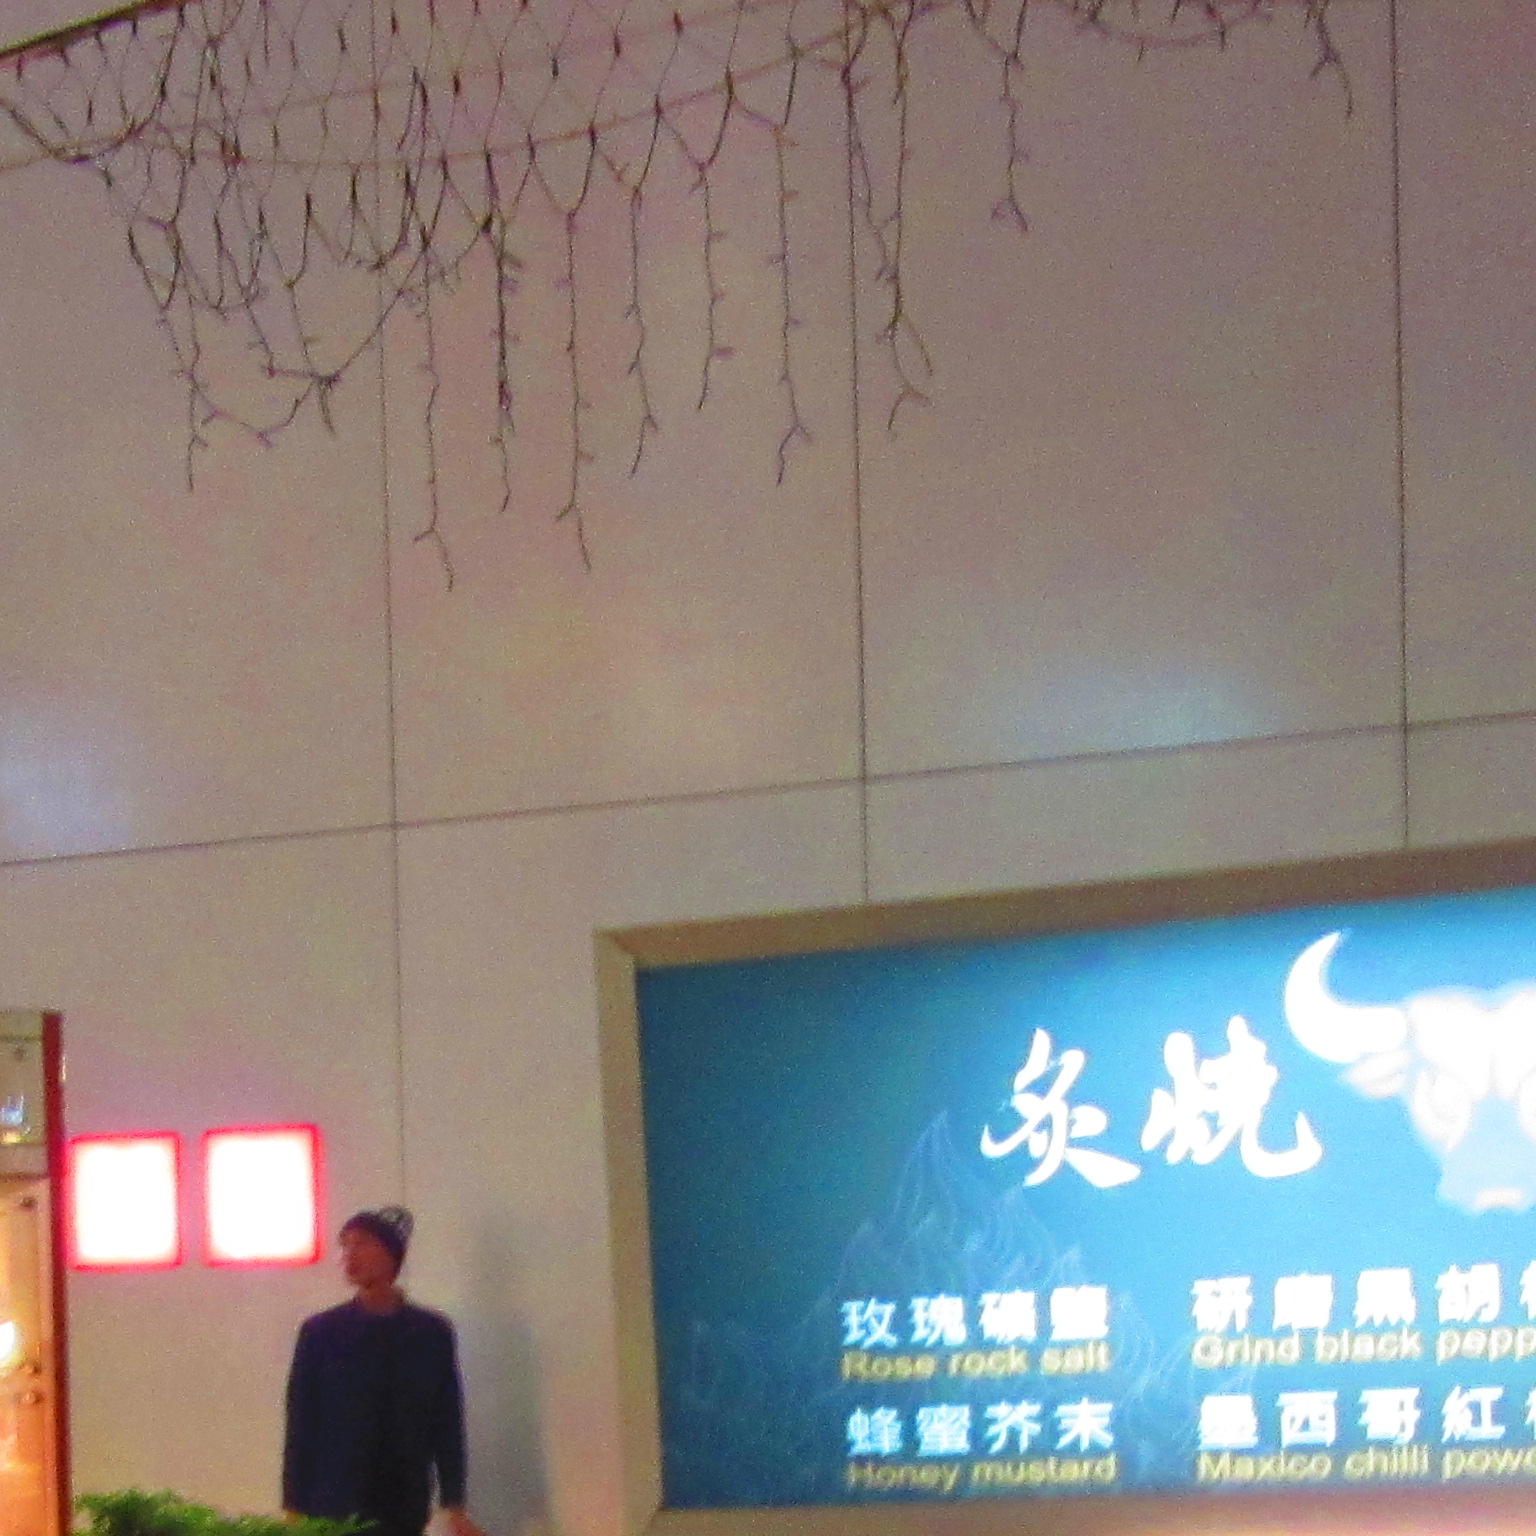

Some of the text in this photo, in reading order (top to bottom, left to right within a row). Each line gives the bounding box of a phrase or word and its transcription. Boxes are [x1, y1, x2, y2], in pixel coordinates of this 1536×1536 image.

[841, 1341, 1110, 1381] Rose rock salt
[1191, 1330, 1302, 1368] Grind
[1315, 1327, 1422, 1364] black
[847, 1397, 1115, 1457] 蜂蜜芥末
[847, 1453, 1116, 1494] Honey mustard
[1197, 1450, 1332, 1481] Mexico
[1344, 1444, 1430, 1479] chilli
